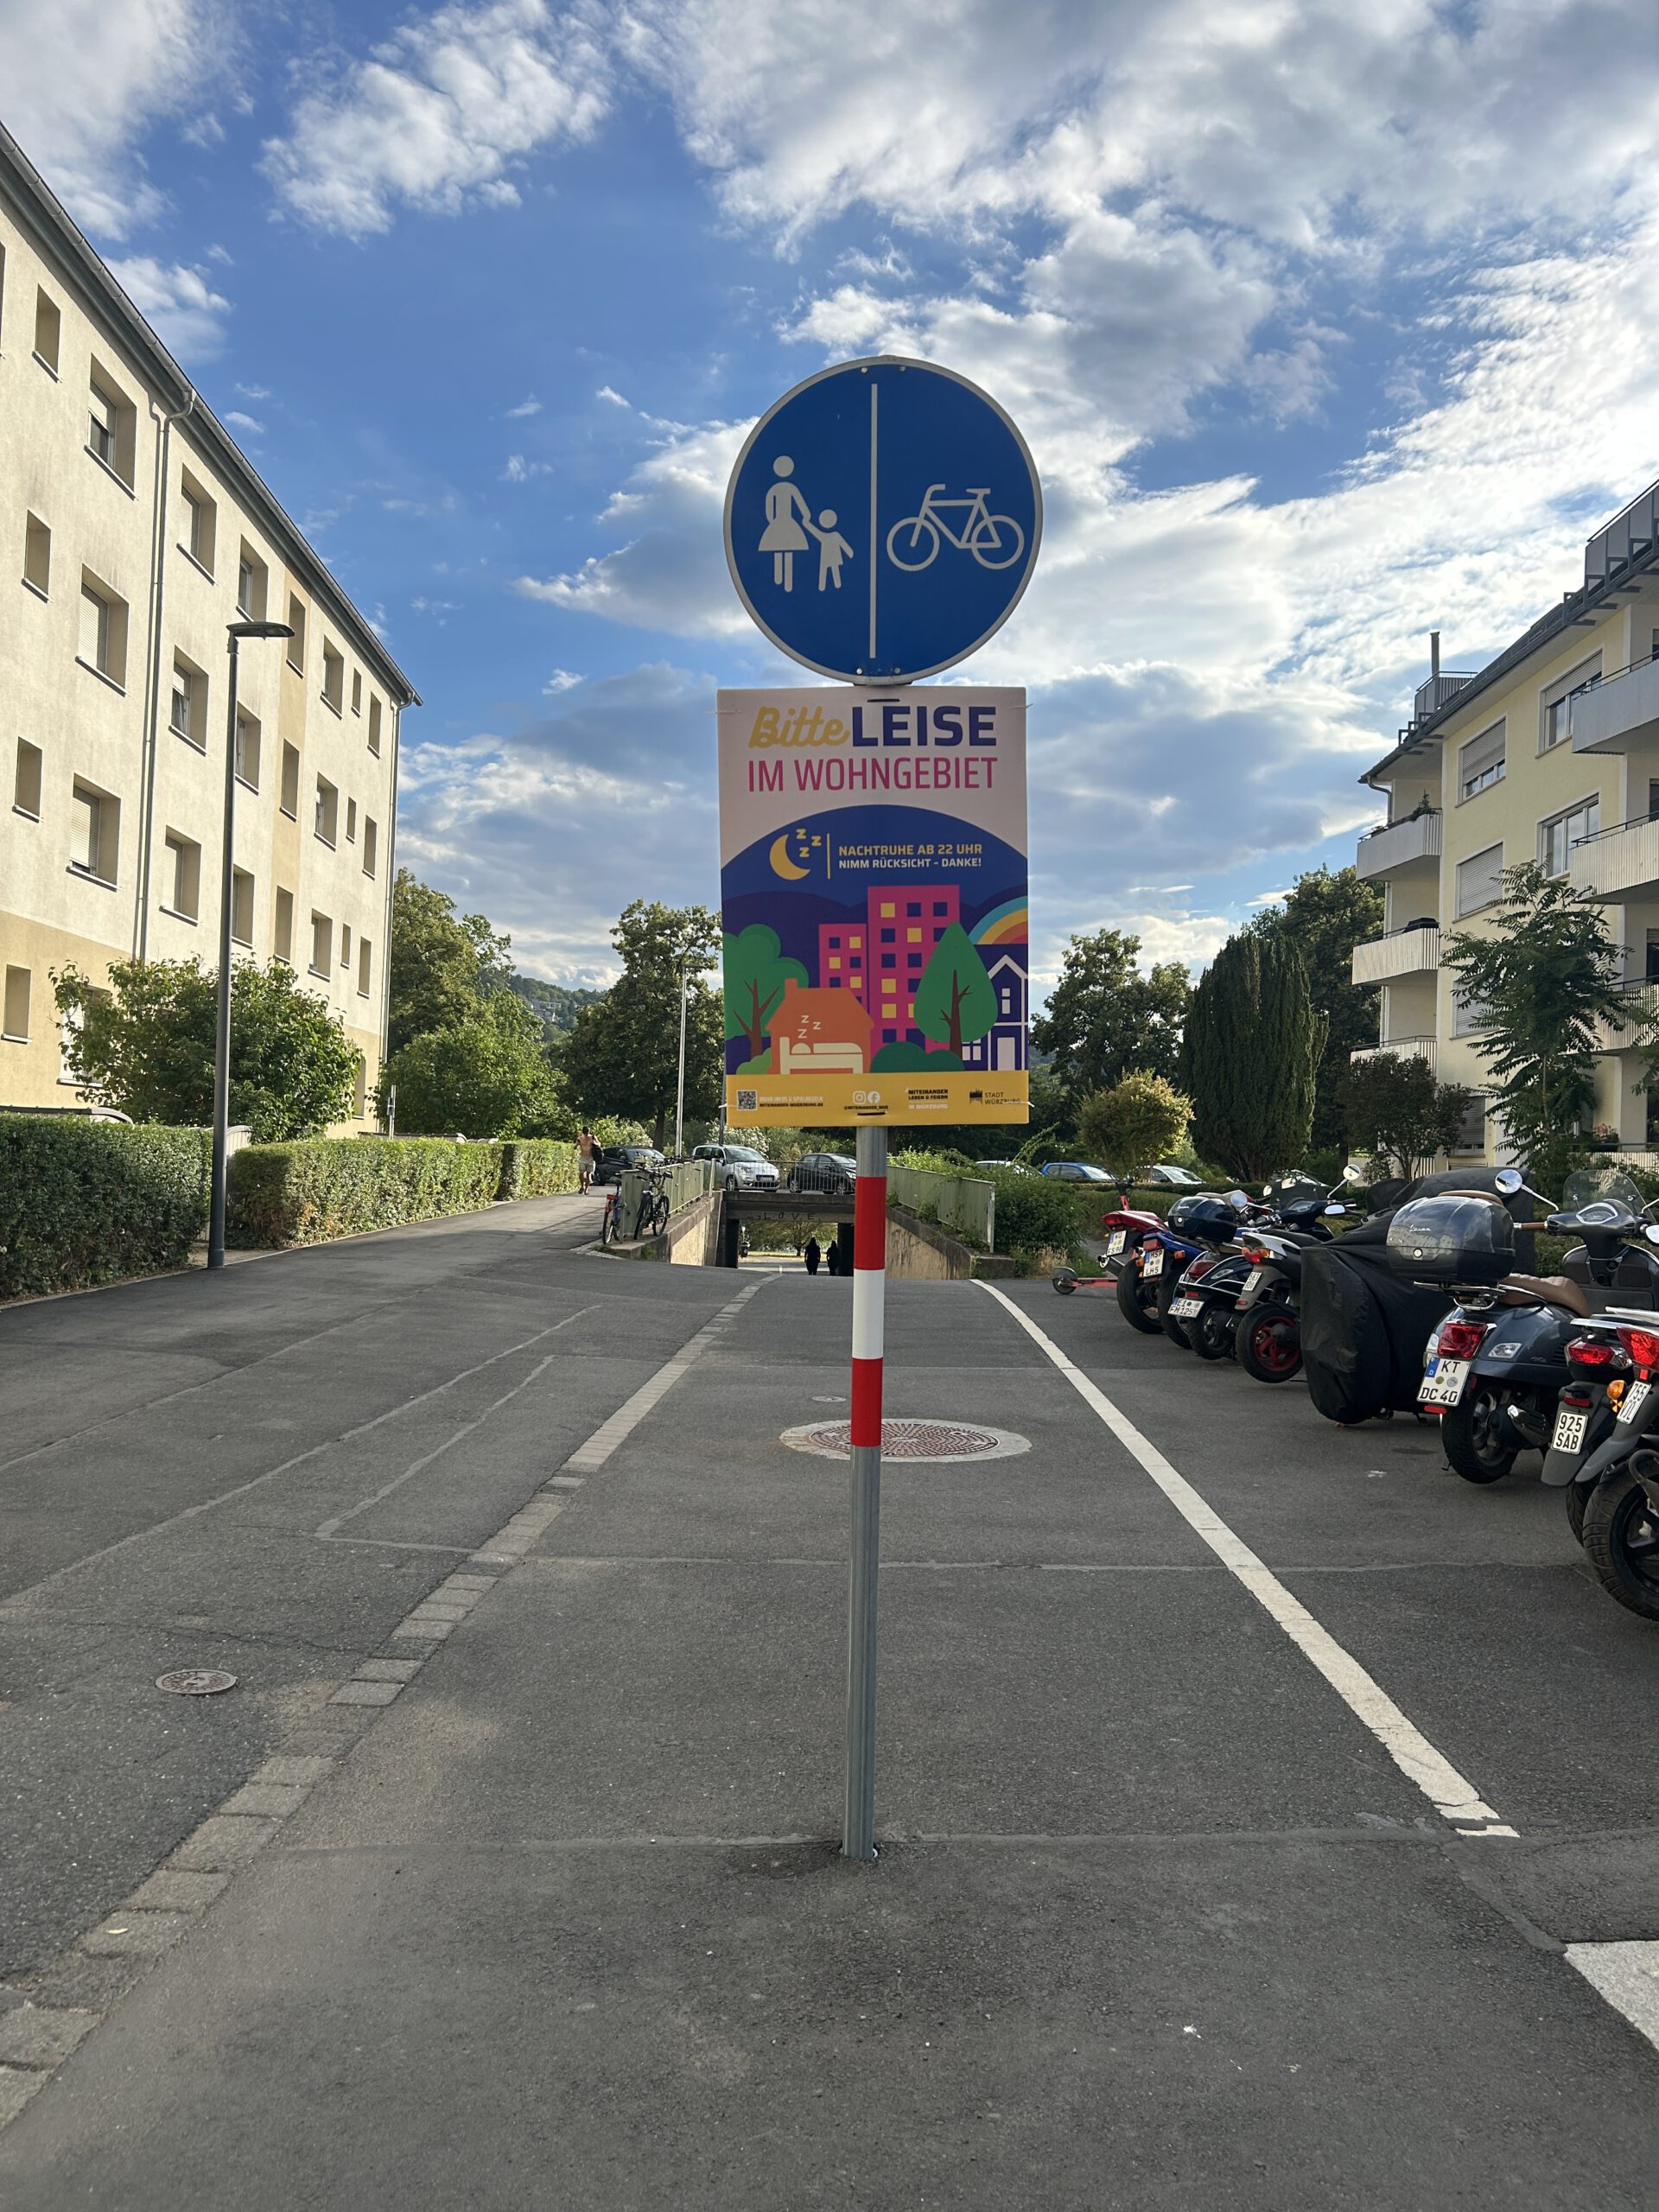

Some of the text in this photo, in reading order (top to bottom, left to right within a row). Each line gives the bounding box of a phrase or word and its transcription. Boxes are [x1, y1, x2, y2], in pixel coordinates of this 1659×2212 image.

[748, 706, 996, 748] Bitte LEISE
[748, 757, 997, 791] IM WOHNGEBIET
[838, 844, 982, 856] NACHTRUHE AB 22 UHR
[838, 860, 869, 869] NIMM
[872, 857, 931, 868] RÜCKSICHT
[941, 858, 982, 867] DANKE!
[1440, 1360, 1461, 1374] KT
[1420, 1387, 1459, 1403] DC 40
[1559, 1414, 1583, 1433] 925
[1555, 1432, 1580, 1450] SAB
